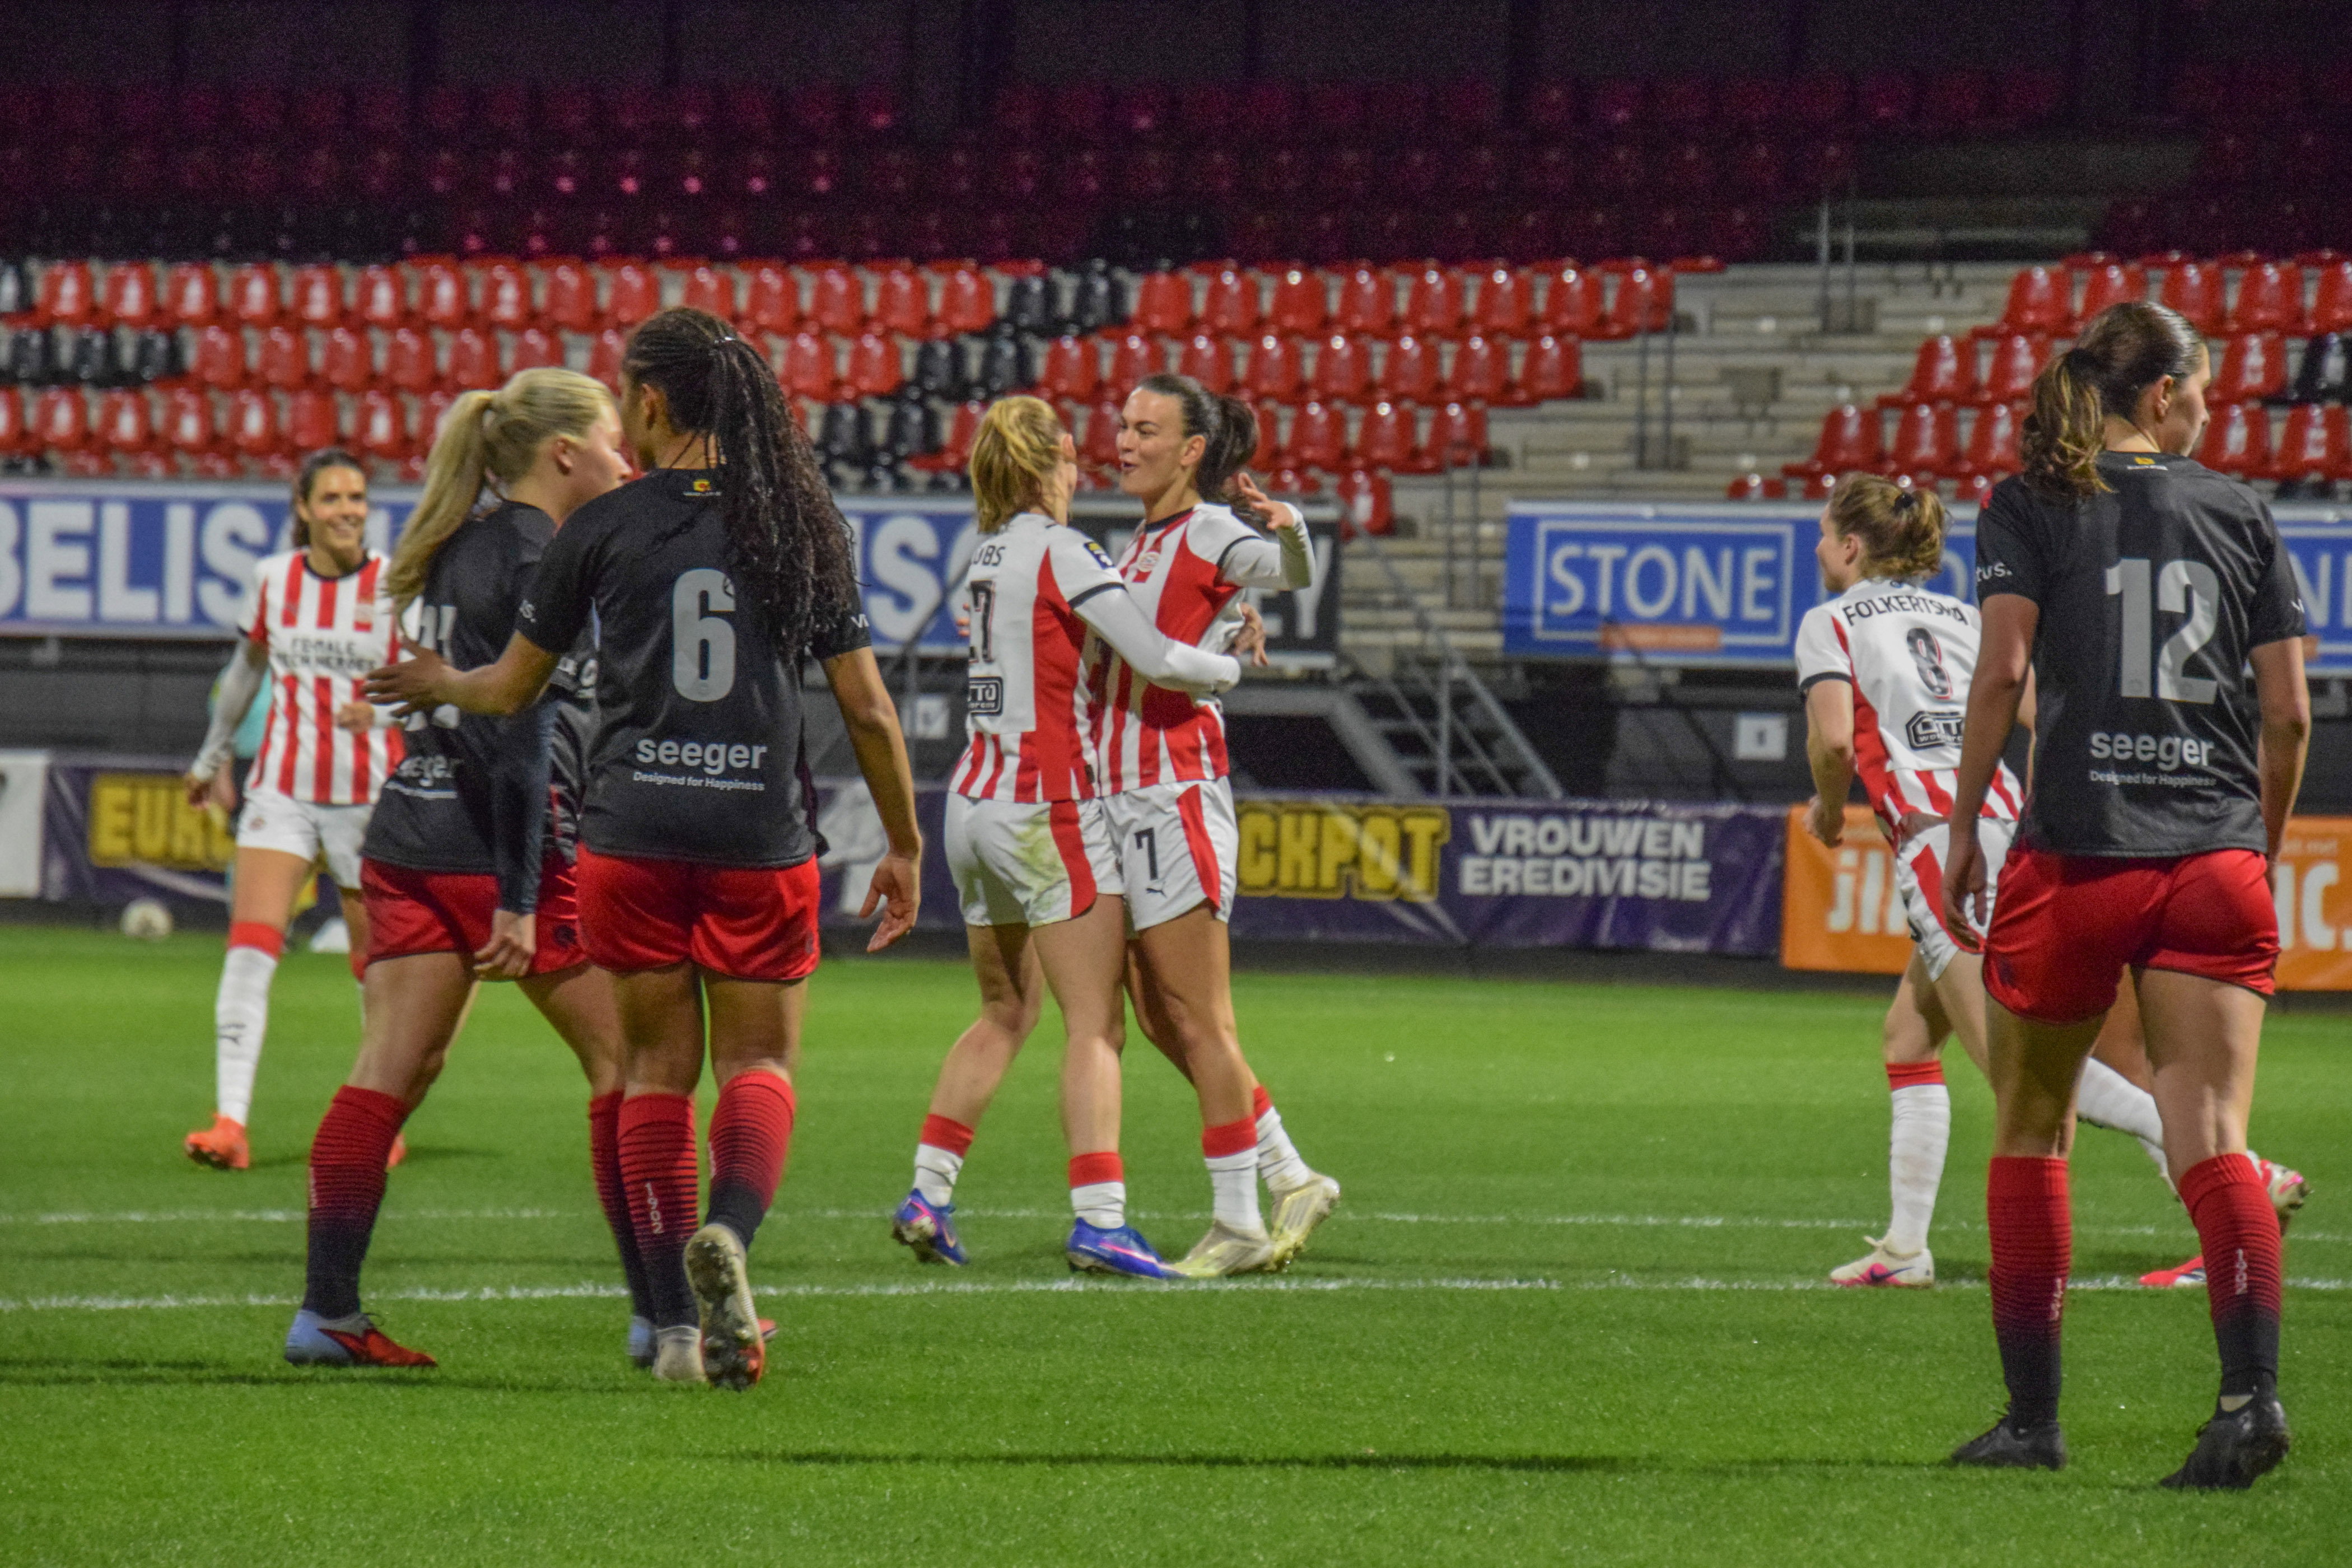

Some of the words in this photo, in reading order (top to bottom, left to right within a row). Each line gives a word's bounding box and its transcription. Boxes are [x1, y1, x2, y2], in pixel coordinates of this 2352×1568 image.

[0, 500, 390, 626] ELIS
[1551, 545, 1776, 620] STONE
[673, 568, 735, 702] 6
[969, 580, 996, 662] 7
[2106, 558, 2219, 704] 12
[1907, 627, 1953, 699] 8
[636, 738, 767, 775] seeger
[2090, 732, 2214, 771] seeger
[2090, 770, 2141, 785] Designed
[2142, 773, 2157, 784] for
[633, 771, 685, 785] Designed
[687, 776, 704, 787] for
[705, 777, 765, 791] Happiness
[1133, 828, 1158, 880] 7
[1236, 811, 1442, 892] CKPOT
[1469, 813, 1705, 858] VROUWEN
[1458, 855, 1711, 901] EREDIVISIE
[645, 1182, 665, 1234] 1902
